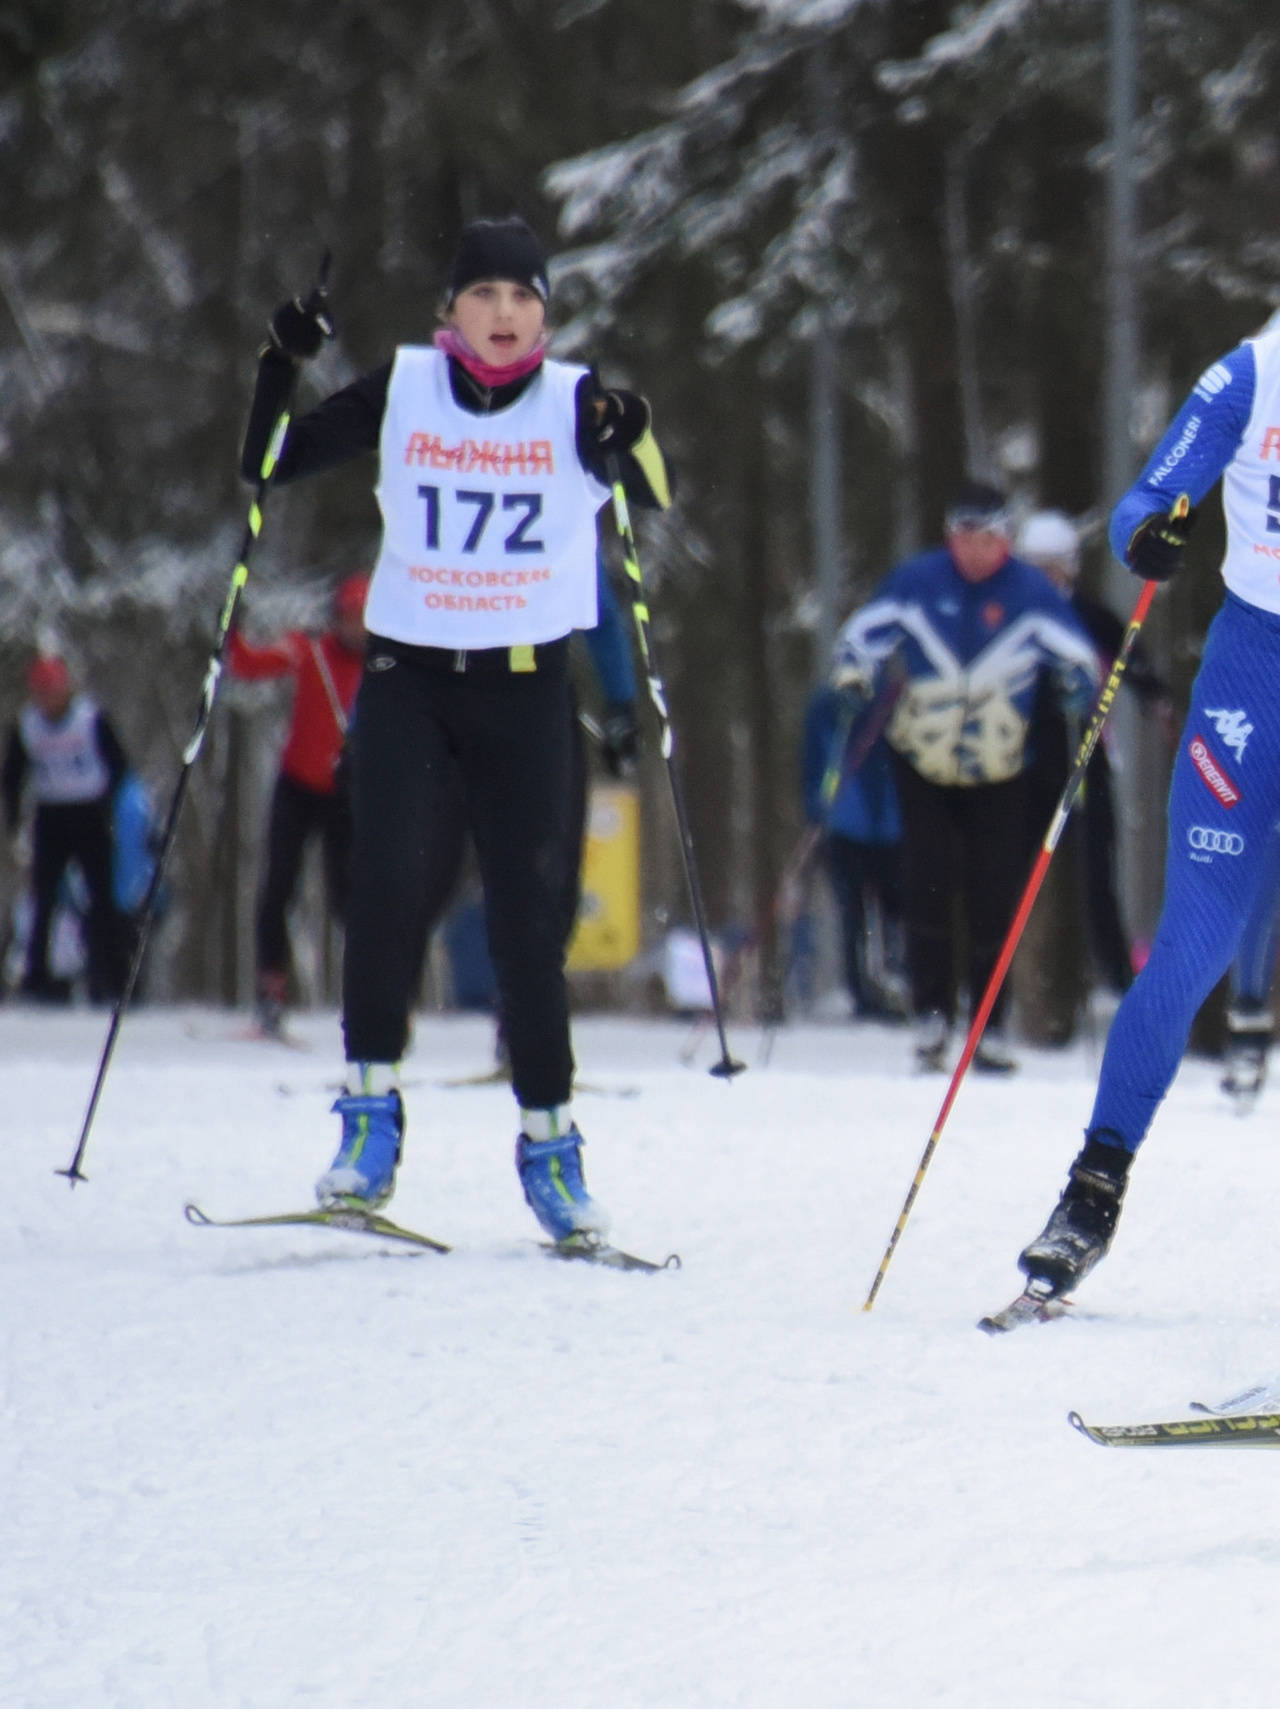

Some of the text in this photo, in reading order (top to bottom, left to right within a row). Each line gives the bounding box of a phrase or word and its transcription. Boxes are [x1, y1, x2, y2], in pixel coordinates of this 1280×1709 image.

[404, 431, 554, 476] ЛЫЖНЯ
[1147, 416, 1202, 486] FALCONERI
[417, 484, 545, 554] 172
[424, 593, 527, 611] ОБЛАСТЬ
[1197, 757, 1238, 803] ENERVIT
[1189, 851, 1212, 864] Audi
